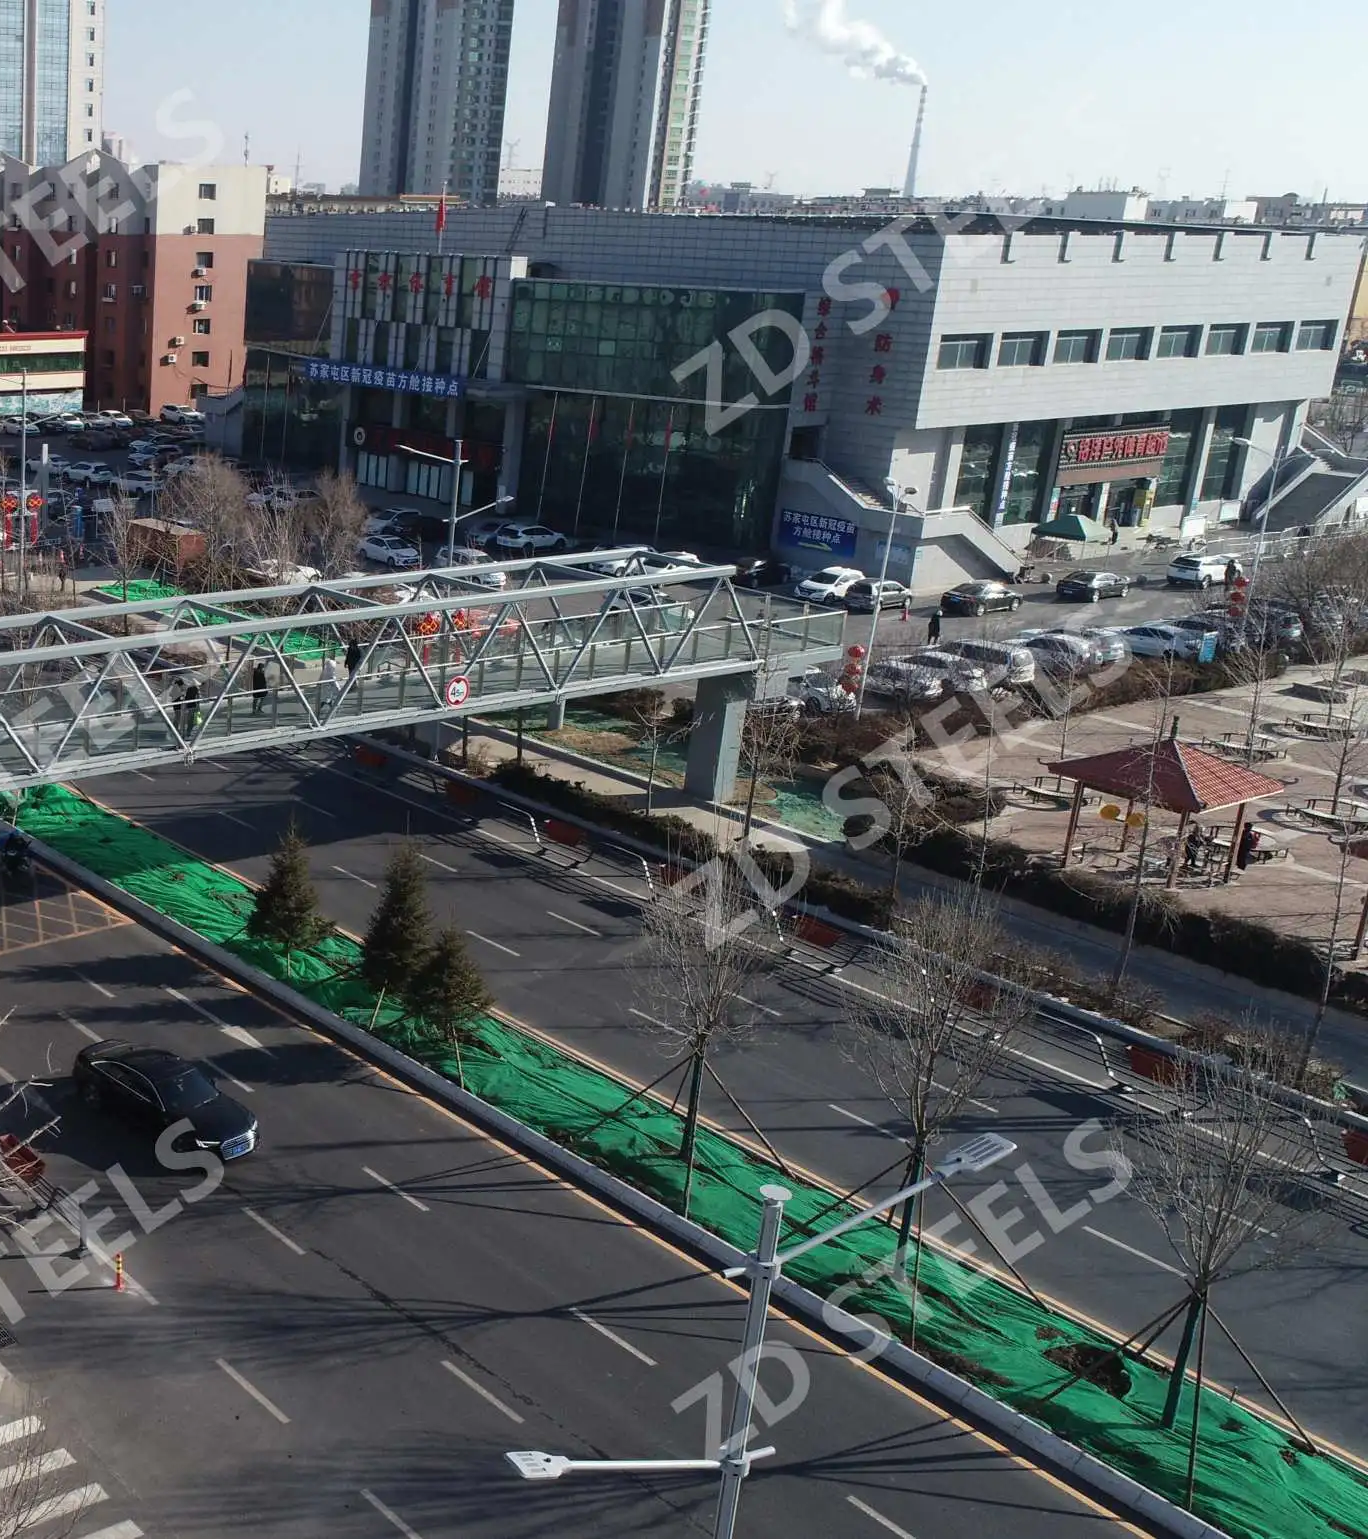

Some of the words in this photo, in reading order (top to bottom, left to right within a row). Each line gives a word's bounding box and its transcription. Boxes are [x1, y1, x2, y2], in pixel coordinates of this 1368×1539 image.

[309, 362, 459, 396] 苏家屯区新冠疫苗方舱接种点
[865, 333, 894, 415] 防身术
[783, 511, 856, 534] 苏家屯区新冠疫苗
[793, 526, 842, 544] 方舱接种点
